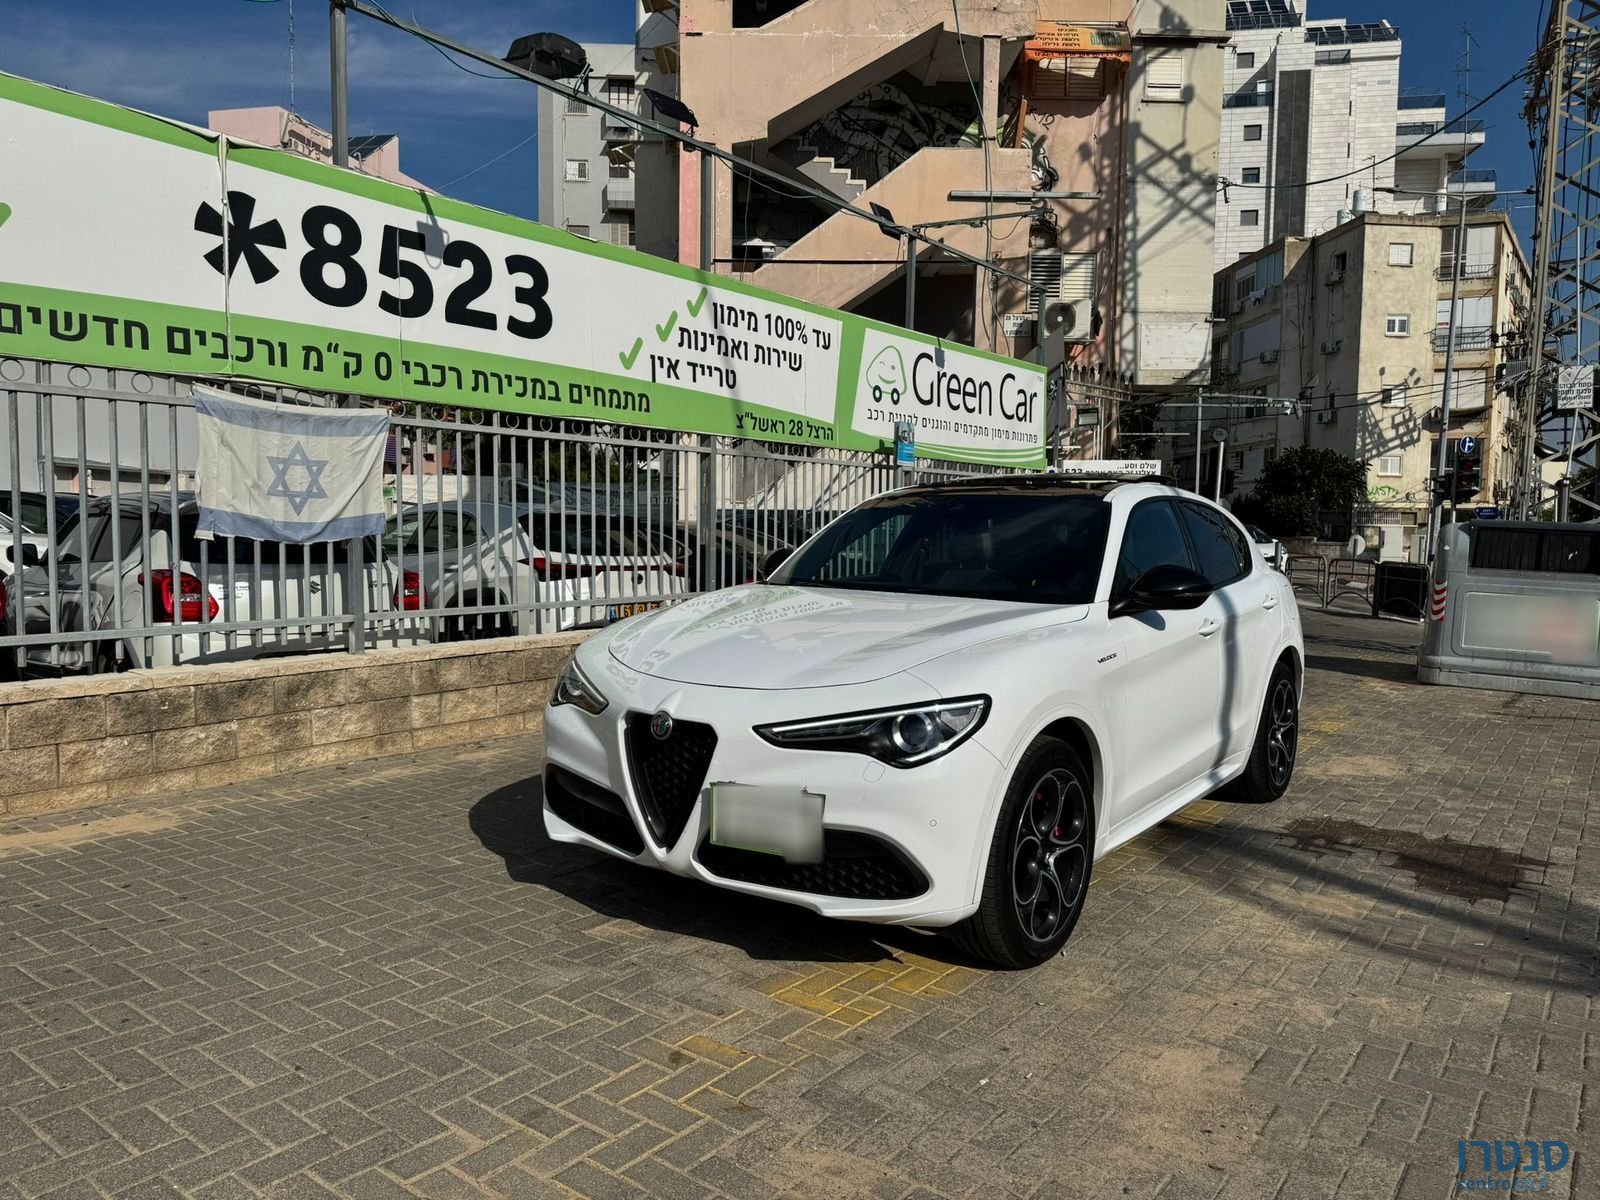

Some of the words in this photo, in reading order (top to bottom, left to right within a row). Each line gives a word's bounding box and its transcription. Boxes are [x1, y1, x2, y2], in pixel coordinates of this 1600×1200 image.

[0, 302, 150, 351] חדשים
[712, 302, 758, 333] מימון
[764, 313, 808, 344] 100%
[166, 325, 288, 368] ורכבים
[678, 324, 749, 361] ואמינות
[812, 328, 831, 350] עד
[374, 351, 393, 382] 0
[650, 354, 680, 383] אין
[754, 343, 803, 372] שירות
[401, 359, 463, 391] רכבי
[471, 369, 562, 402] במכירת
[687, 361, 737, 389] טרייד
[912, 352, 992, 417] Green
[1000, 373, 1038, 424] Car
[569, 382, 651, 414] מתמחים
[736, 411, 785, 434] ראשל"צ
[788, 419, 804, 437] 28
[867, 408, 885, 422] רכב
[921, 417, 951, 432] והוגנים
[954, 422, 989, 437] מתקדמים
[806, 420, 834, 441] הרצל
[991, 427, 1010, 441] מימון
[1011, 430, 1038, 444] פתרונות
